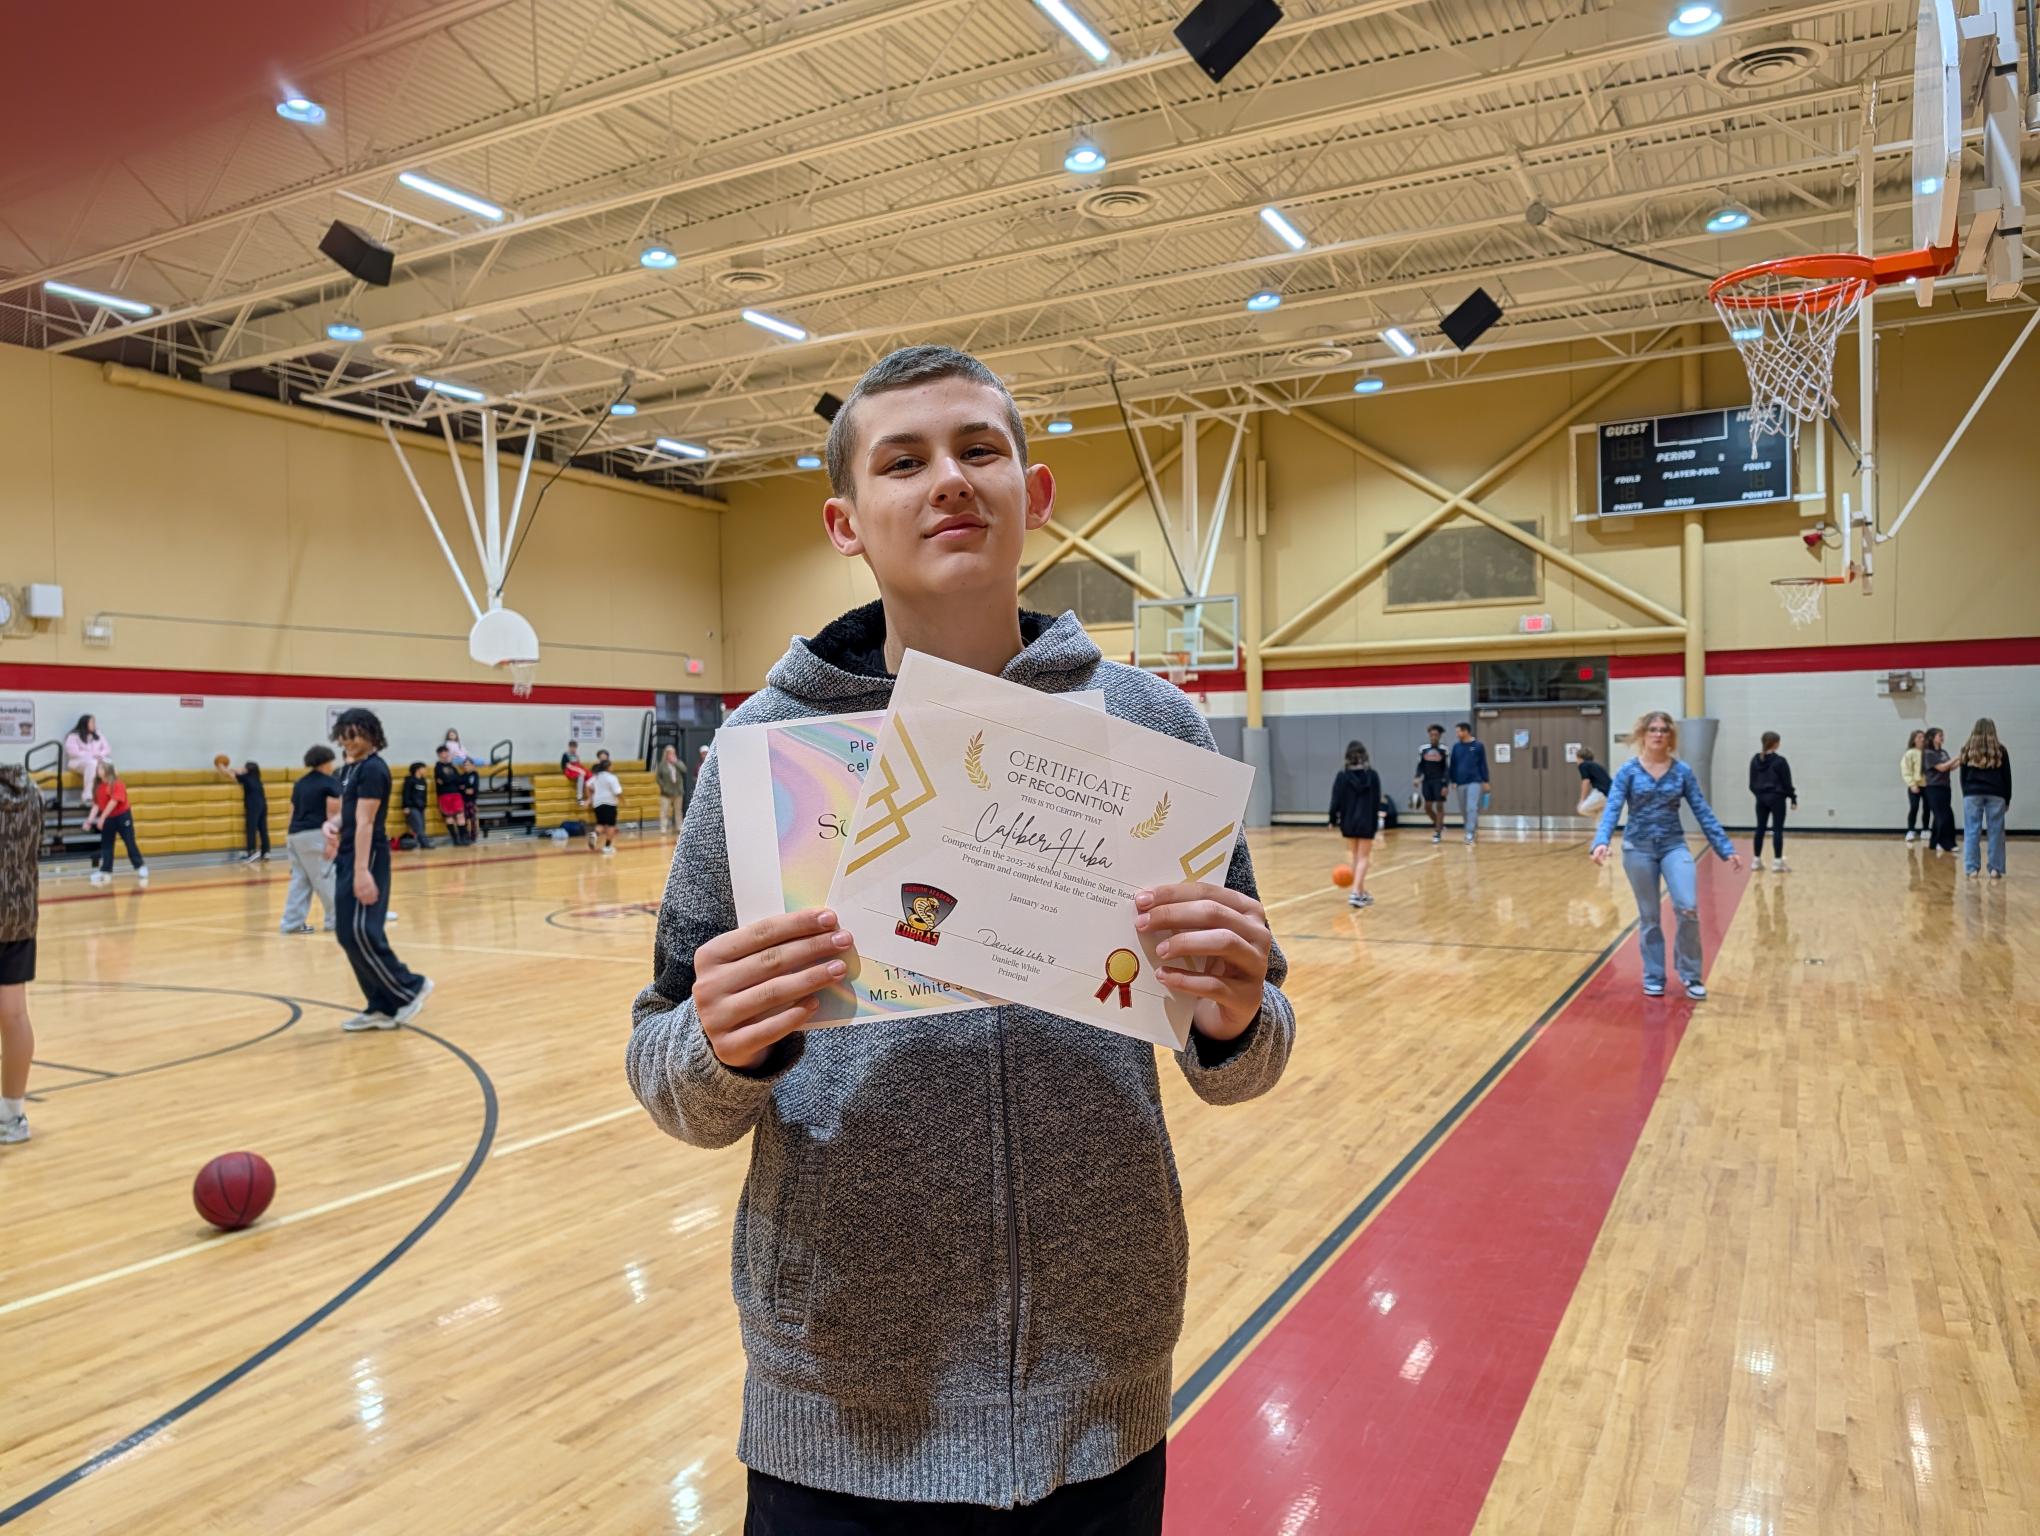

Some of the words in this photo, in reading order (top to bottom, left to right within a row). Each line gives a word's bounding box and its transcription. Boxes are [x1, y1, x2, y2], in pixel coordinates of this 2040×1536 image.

[1605, 422, 1648, 437] GUEST
[1656, 449, 1696, 462] PERIOD
[850, 740, 874, 753] Ple
[1009, 750, 1132, 802] CERTIFICATE
[1007, 771, 1028, 785] OF
[1028, 777, 1124, 817] RECOGNITION
[1021, 794, 1037, 805] THIS
[1037, 799, 1045, 807] IS
[1045, 801, 1055, 810] TO
[1055, 805, 1083, 820] CERTIFY
[1084, 814, 1103, 826] THAT
[975, 802, 1051, 853] Caliber
[1050, 828, 1113, 870] Huba
[942, 834, 982, 853] Competed
[983, 846, 991, 856] in
[992, 849, 1005, 860] the
[1006, 855, 1036, 870] 2025-26
[1036, 864, 1061, 878] school
[1062, 871, 1096, 889] Sunshine
[1097, 882, 1117, 896] State
[962, 853, 996, 871] Program
[996, 865, 1012, 875] and
[1012, 870, 1053, 888] completed
[1054, 881, 1071, 894] Kate
[1072, 887, 1085, 898] the
[1086, 891, 1118, 908] Catsitter
[1009, 893, 1039, 910] January
[1040, 903, 1058, 914] 2026
[896, 921, 940, 946] COBRAS
[991, 953, 1020, 968] Danielle
[1021, 962, 1041, 975] White
[998, 967, 1029, 983] Principal
[869, 988, 903, 1002] Mrs.
